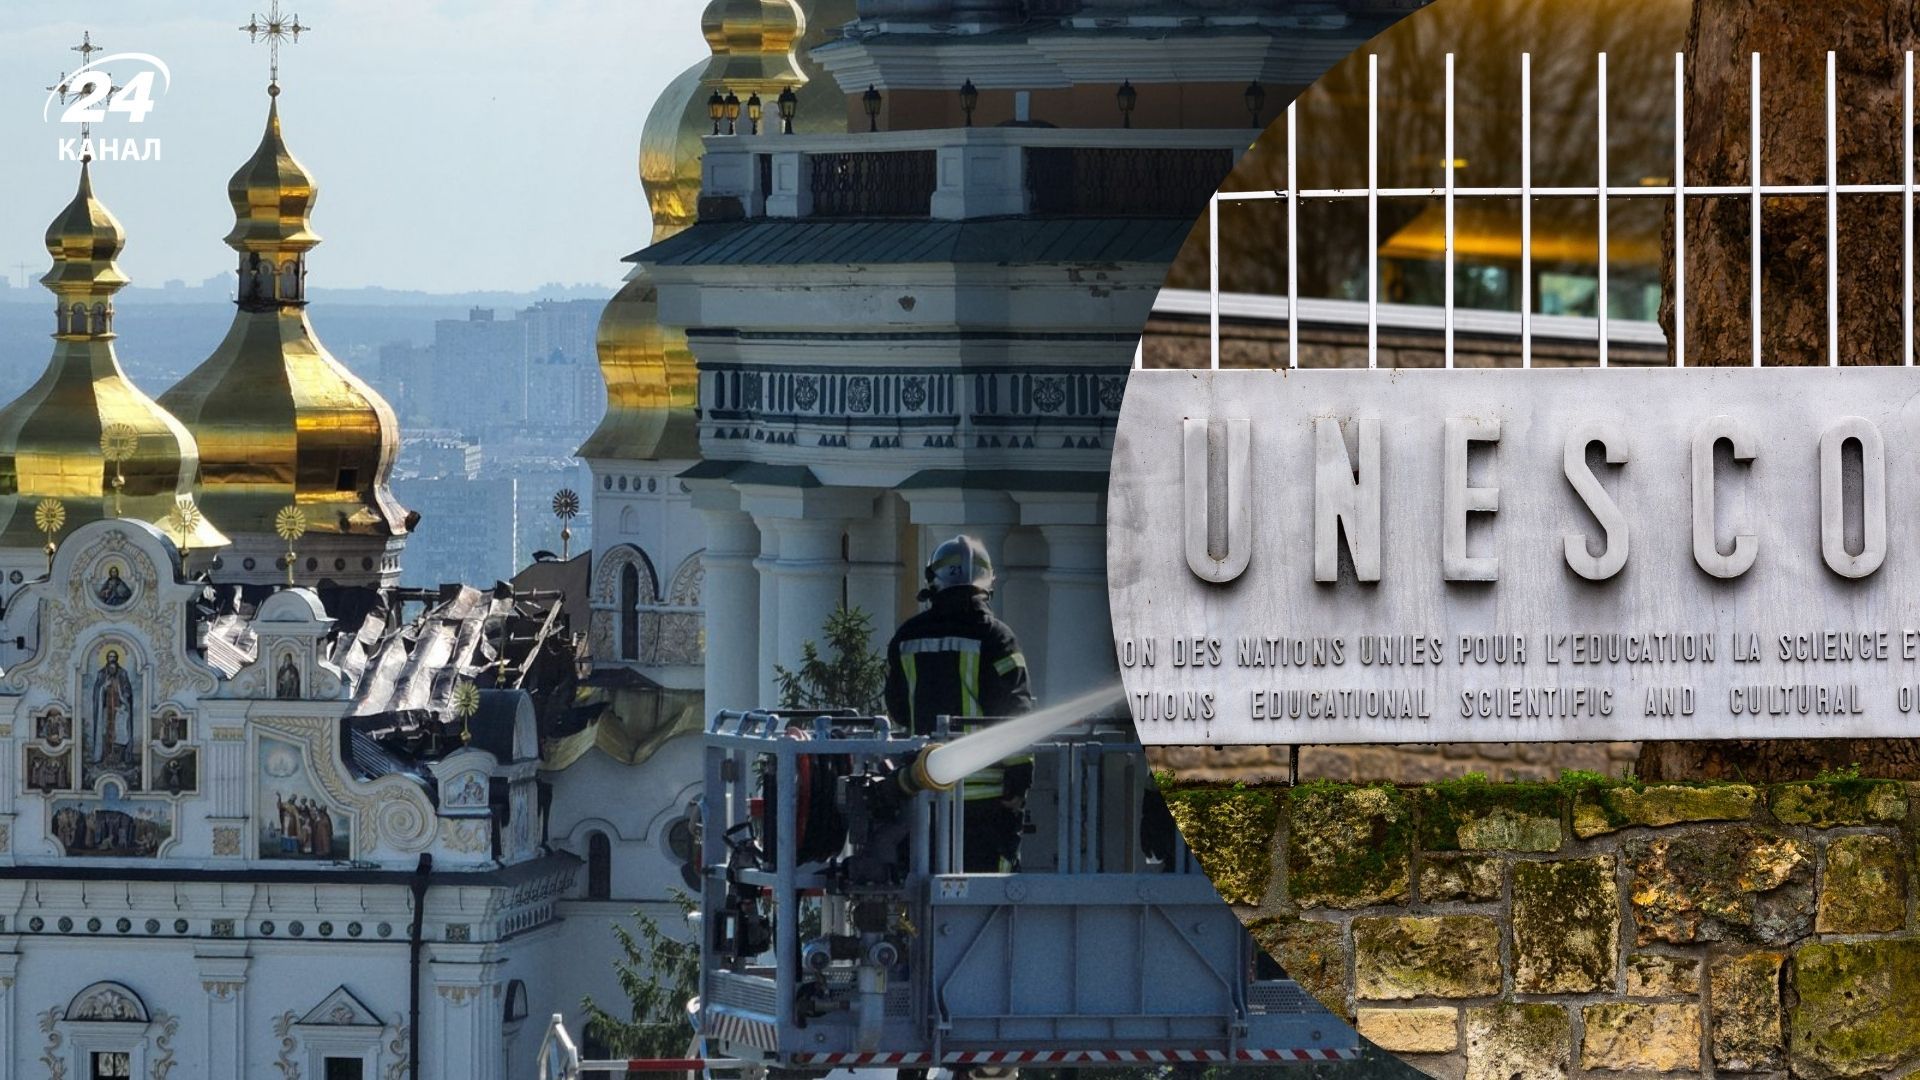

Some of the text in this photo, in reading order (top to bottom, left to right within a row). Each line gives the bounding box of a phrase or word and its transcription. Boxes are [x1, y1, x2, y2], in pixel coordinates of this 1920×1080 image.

[1183, 414, 1887, 584] UNESCO
[1114, 636, 1156, 668] ON
[1173, 636, 1222, 667] DES
[1237, 636, 1346, 667] NATIONS
[1360, 634, 1443, 665] UNIES
[1459, 633, 1527, 664] POUR
[1733, 631, 1762, 662] LA
[1778, 630, 1889, 661] SCIENCE
[1902, 630, 1920, 660] E
[1251, 688, 1431, 719] EDUCATIONAL
[1460, 686, 1614, 718] SCIENTIFIC
[1644, 686, 1696, 716] AND
[1729, 684, 1864, 716] CULTURAL
[1898, 684, 1920, 713] O
